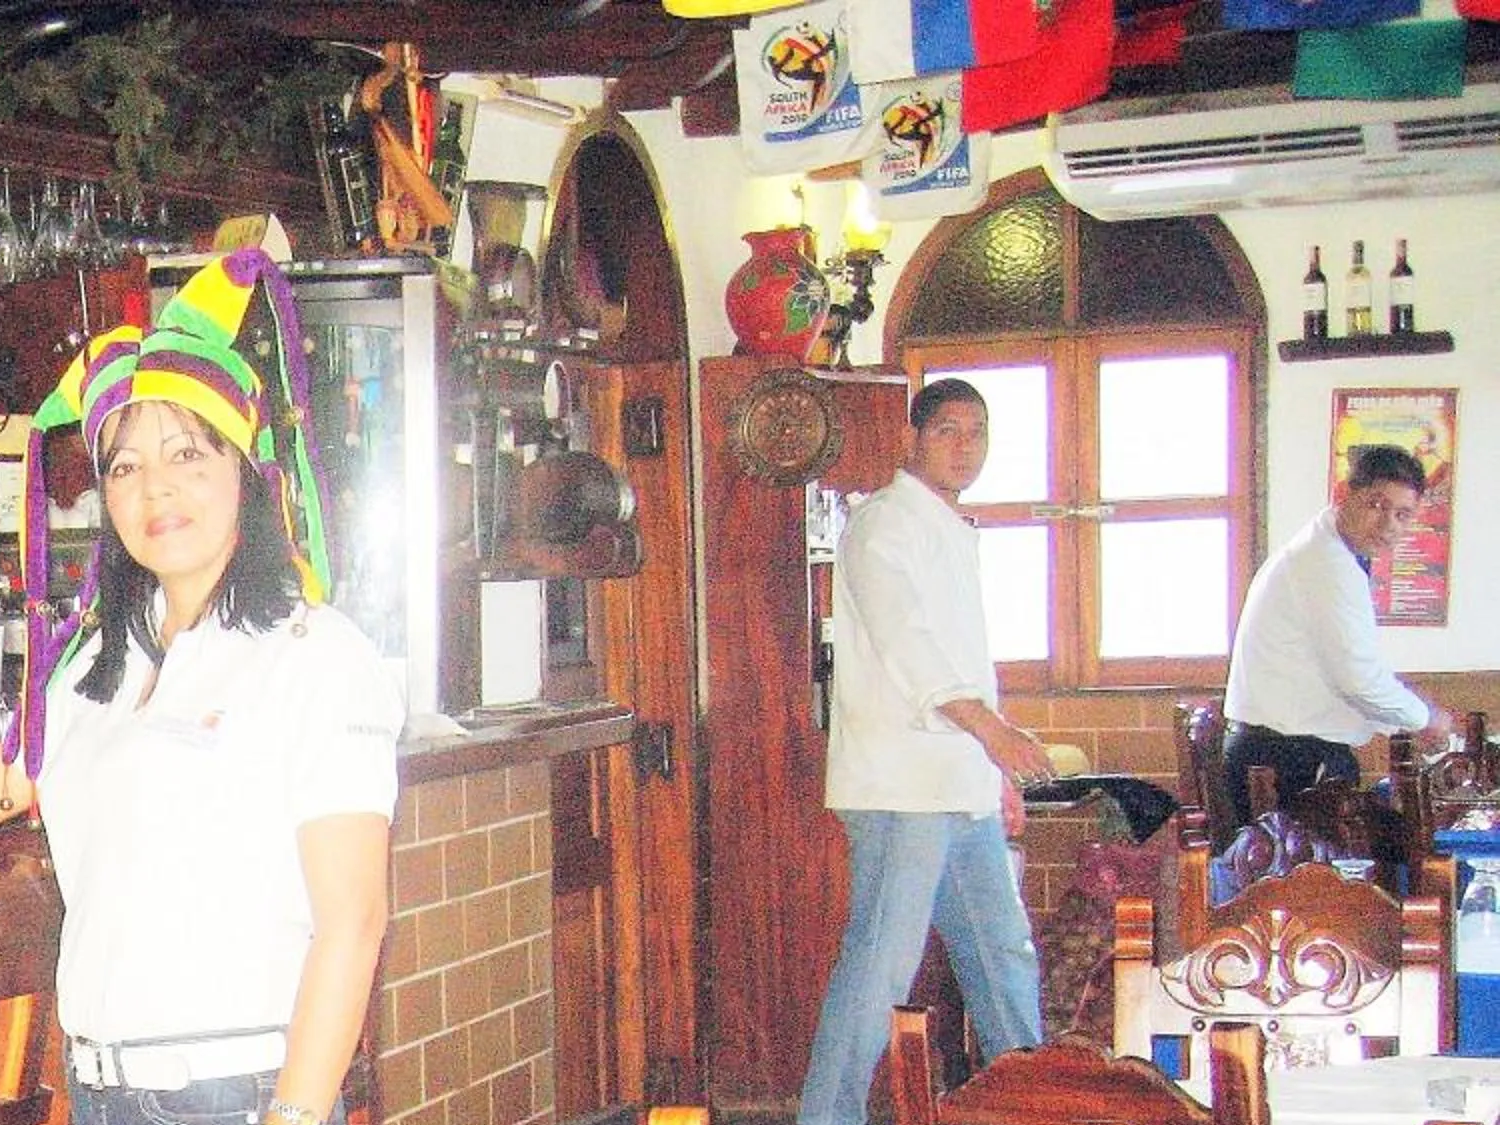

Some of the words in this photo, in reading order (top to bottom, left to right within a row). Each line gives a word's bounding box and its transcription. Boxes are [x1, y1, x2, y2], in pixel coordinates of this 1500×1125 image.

[769, 91, 808, 104] SOUTH
[764, 102, 808, 115] AFRICA
[825, 105, 861, 125] FIFA
[781, 112, 809, 125] 2010
[884, 149, 915, 161] SOUTH
[879, 160, 917, 174] AFRICA
[893, 169, 917, 181] 2010
[937, 167, 969, 182] FIFA
